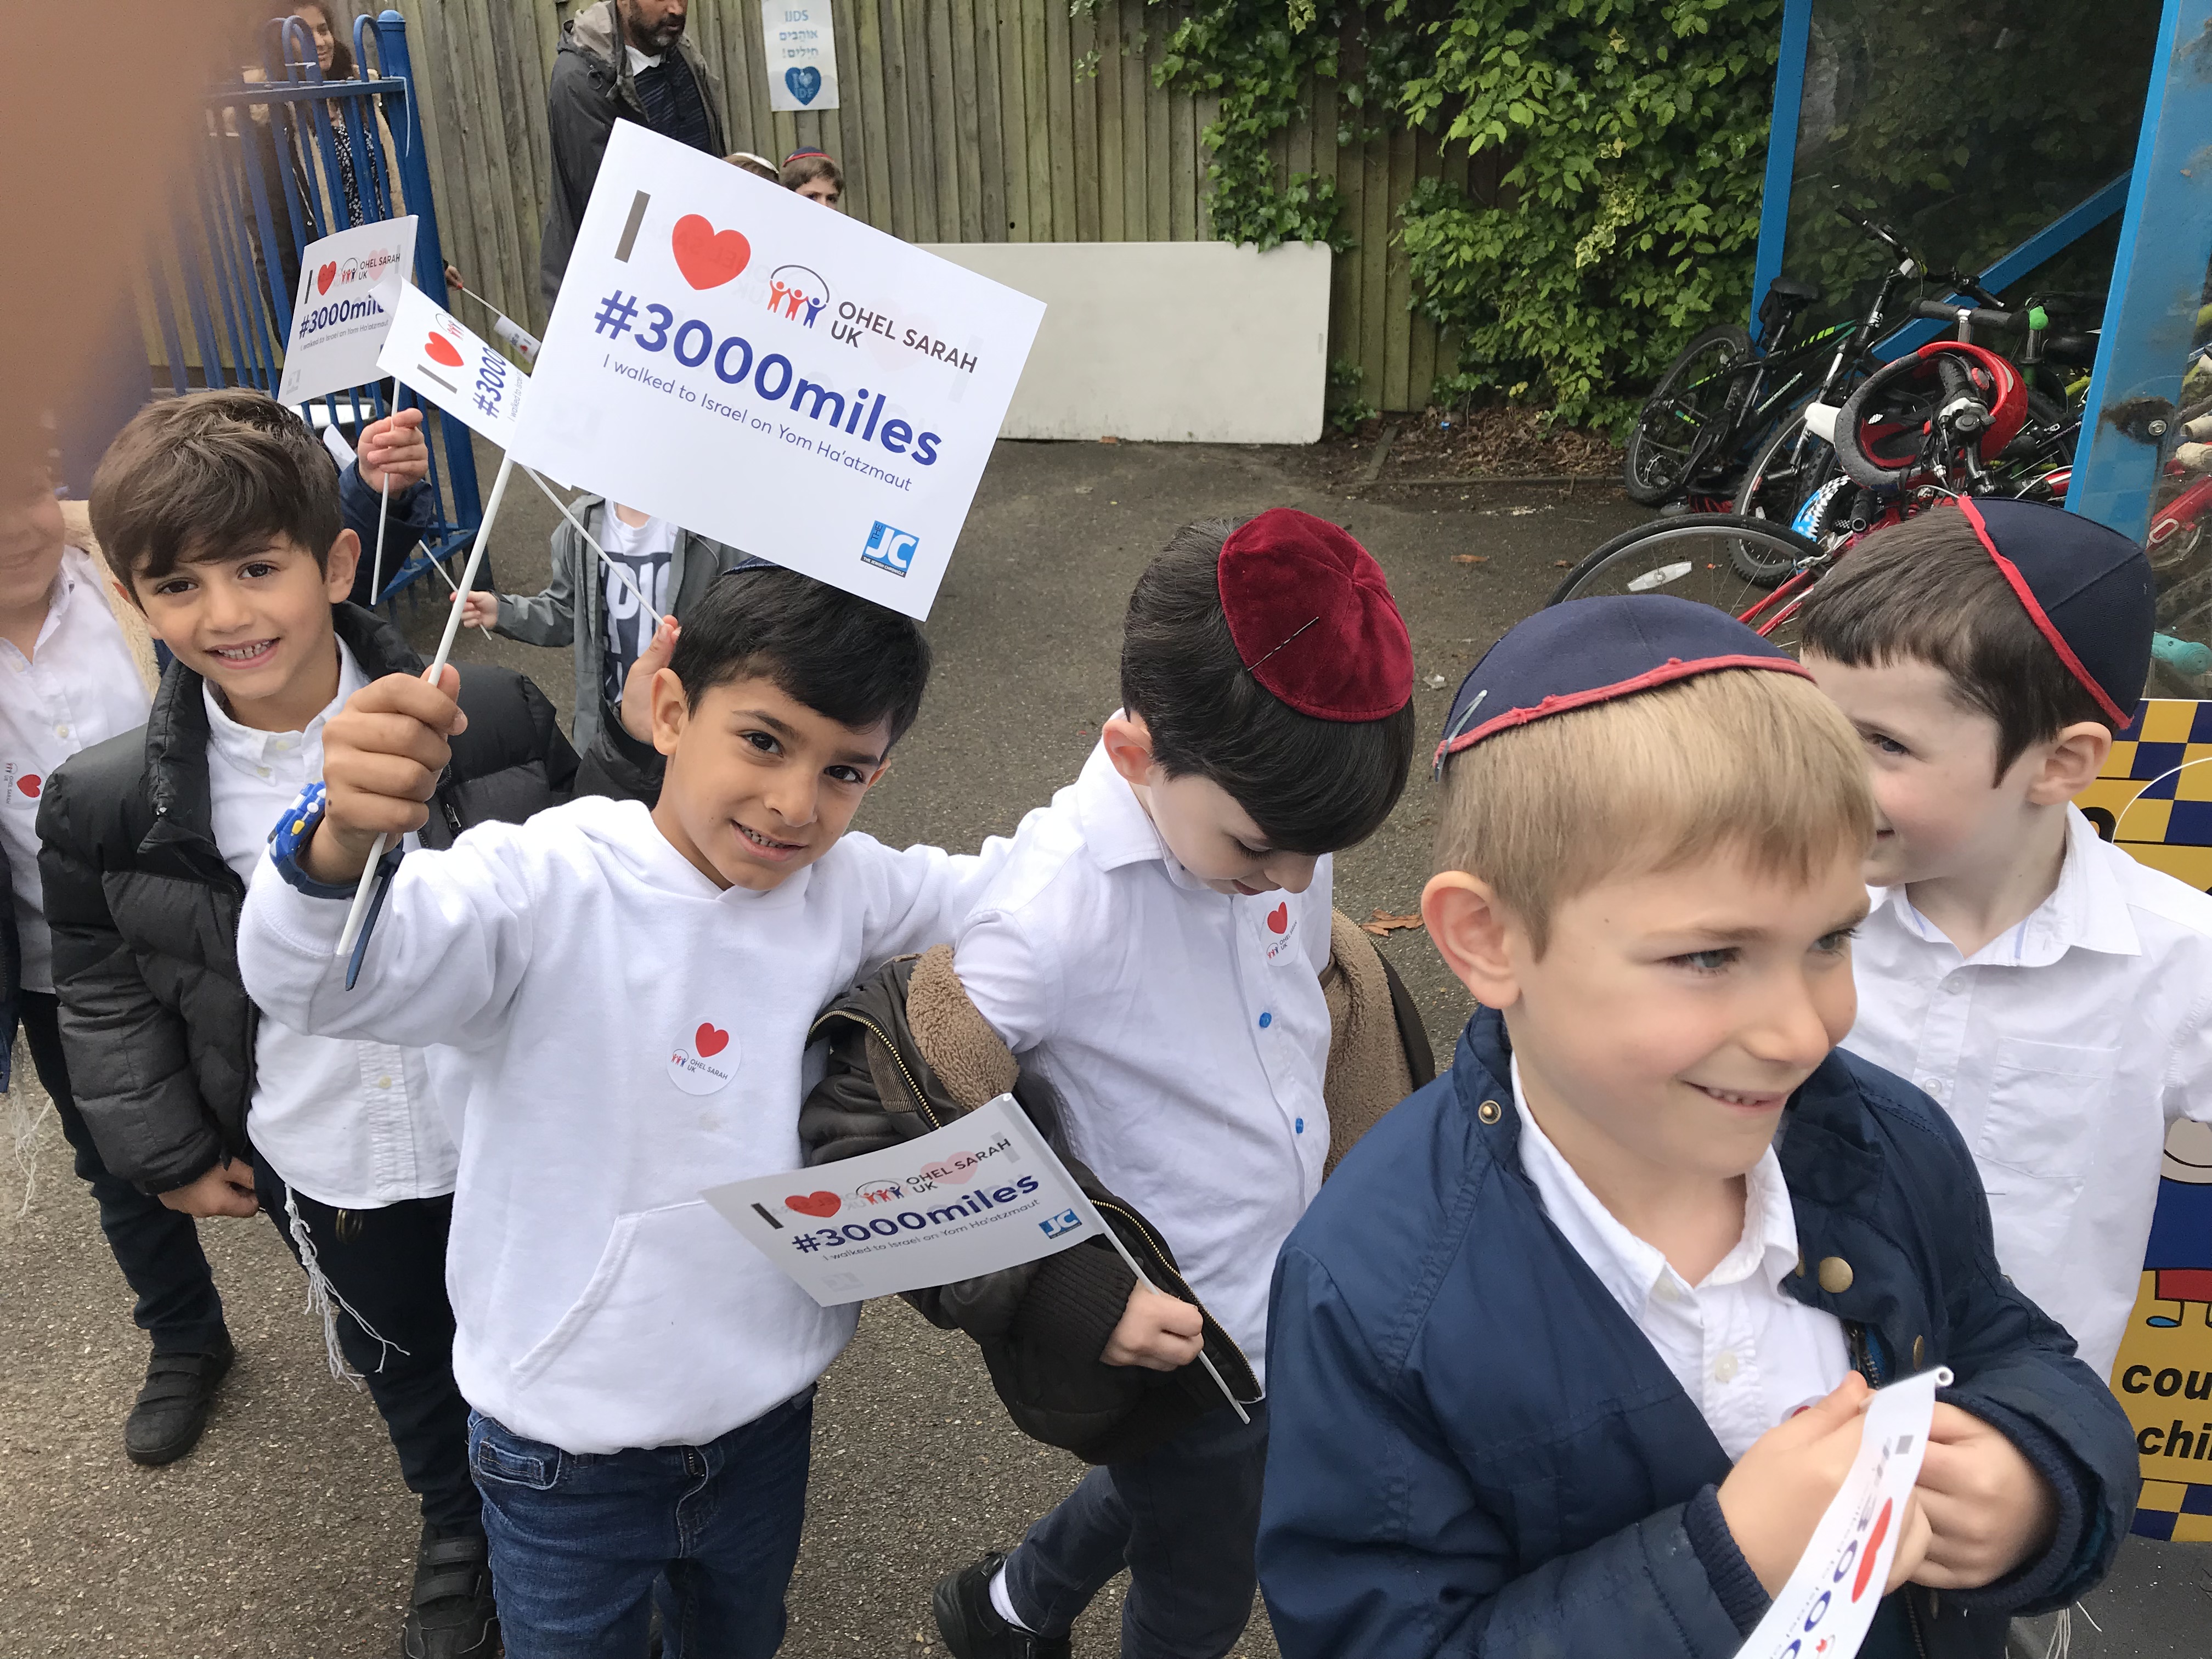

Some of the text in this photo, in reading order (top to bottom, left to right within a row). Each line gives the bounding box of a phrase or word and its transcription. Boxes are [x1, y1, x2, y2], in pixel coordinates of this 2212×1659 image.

[304, 253, 400, 304] I OHEL SARAH
[358, 270, 368, 280] UK
[614, 189, 978, 374] I OHEL SARAH
[299, 294, 384, 340] #3000mil
[831, 320, 864, 348] UK
[303, 338, 319, 350] walked
[325, 331, 339, 342] Israel
[347, 327, 359, 335] Yom
[417, 363, 458, 394] I
[594, 290, 942, 466] #3000miles
[603, 353, 913, 492] I walked to Israel on Yom Ha'atzmaut
[865, 527, 917, 568] JC
[1279, 934, 1291, 945] OHEL
[1280, 942, 1288, 950] UK
[687, 1064, 697, 1073] UK
[690, 1059, 729, 1080] OHEL SARAH
[751, 1138, 1011, 1230] I OHEL SARAH
[912, 1181, 939, 1193] UK
[792, 1175, 1039, 1254] #3000miles
[1045, 1210, 1079, 1235] JC
[830, 1245, 871, 1261] walked
[873, 1243, 887, 1251] to
[888, 1236, 921, 1249] Israel
[923, 1233, 940, 1242] on
[939, 1223, 969, 1236] Yom
[2138, 1420, 2212, 1461] chi
